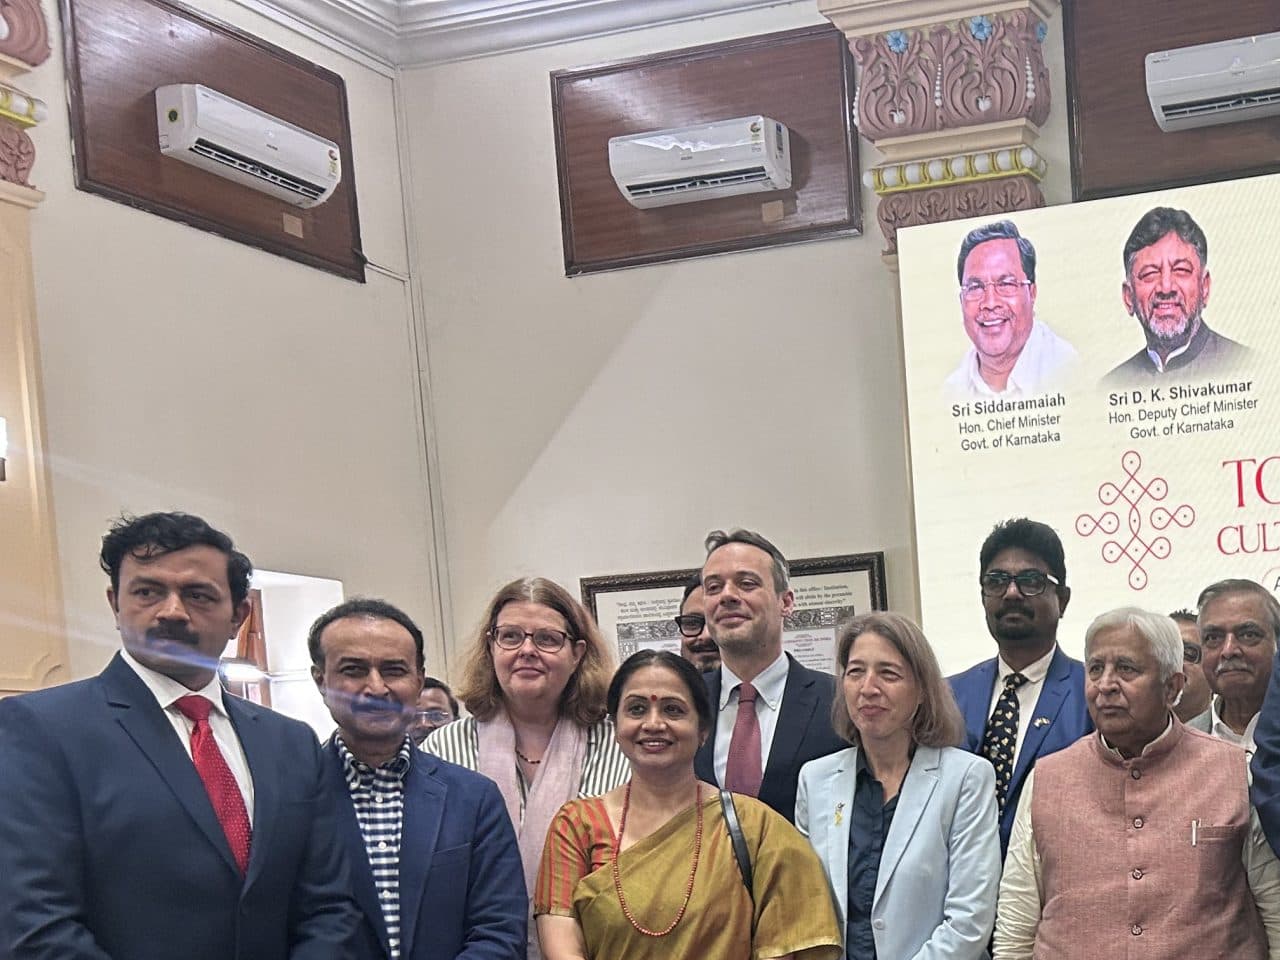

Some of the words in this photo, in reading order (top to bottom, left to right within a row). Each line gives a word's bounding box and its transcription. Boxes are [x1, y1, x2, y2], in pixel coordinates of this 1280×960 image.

[952, 403, 970, 417] Sri
[974, 393, 1065, 415] Siddaramaiah
[1109, 392, 1128, 406] Sri
[1132, 391, 1147, 404] D.
[1151, 388, 1165, 402] K.
[1169, 381, 1253, 399] Shivakumar
[1109, 412, 1135, 424] Hon.
[1138, 407, 1177, 422] Deputy
[1180, 401, 1211, 416] Chief
[1213, 398, 1258, 412] Minister
[959, 422, 984, 434] Hon.
[987, 417, 1016, 431] Chief
[1018, 413, 1061, 428] Minister
[1130, 427, 1160, 439] Govt.
[1162, 423, 1174, 436] of
[1176, 417, 1234, 434] Karnataka
[961, 438, 989, 451] Govt.
[992, 435, 1003, 448] of
[1005, 431, 1061, 446] Karnataka
